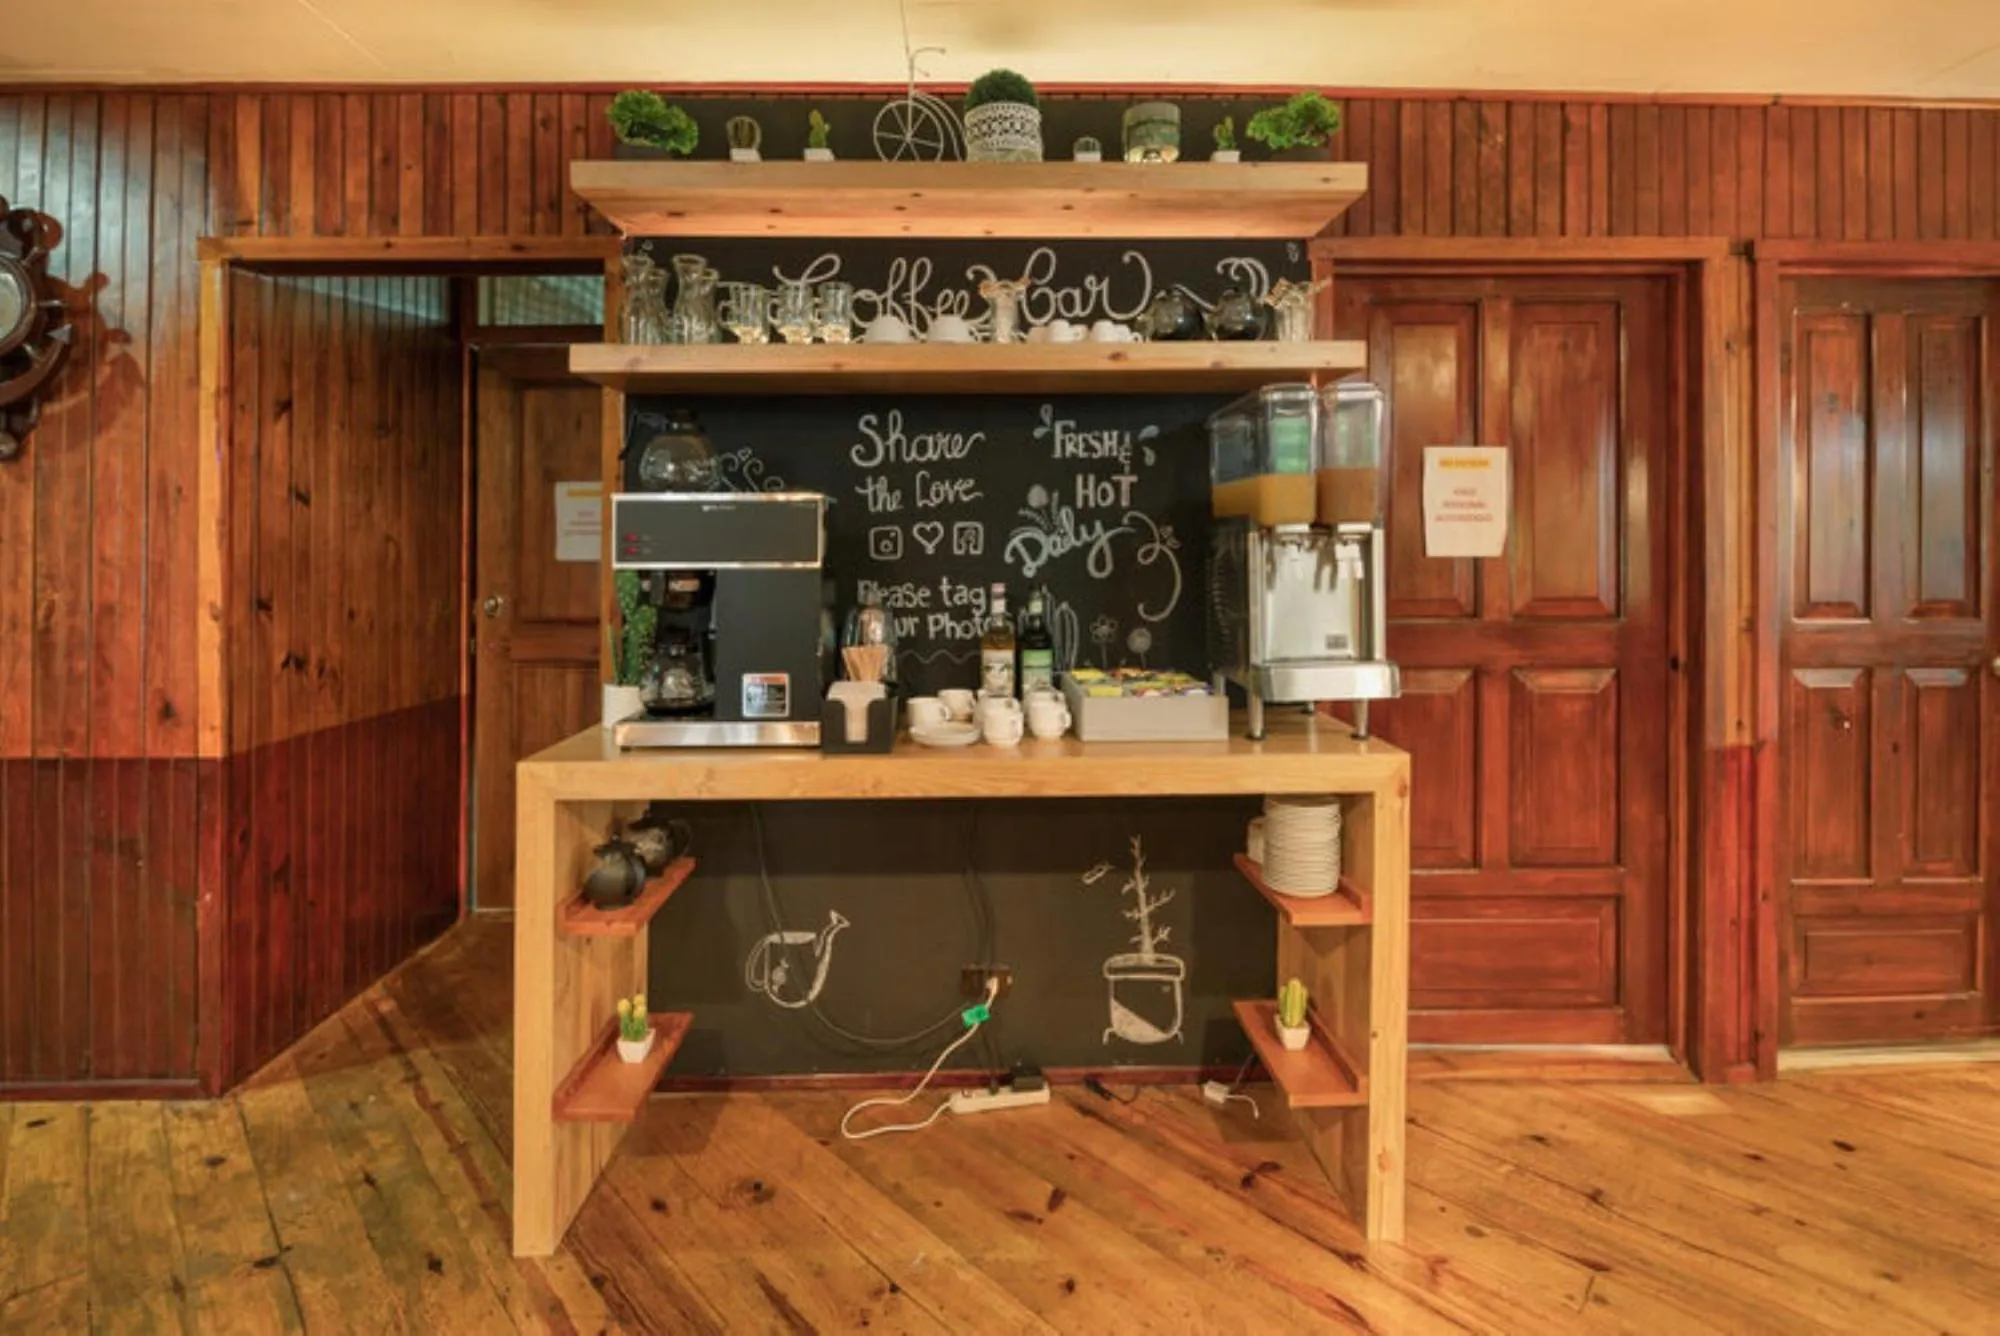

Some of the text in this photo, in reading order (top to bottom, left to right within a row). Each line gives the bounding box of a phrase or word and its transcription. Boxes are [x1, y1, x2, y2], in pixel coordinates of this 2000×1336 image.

[850, 408, 986, 468] Share
[1050, 419, 1119, 459] FRESH
[854, 470, 984, 513] the Love
[1075, 473, 1139, 509] HOT
[939, 575, 986, 616] tag
